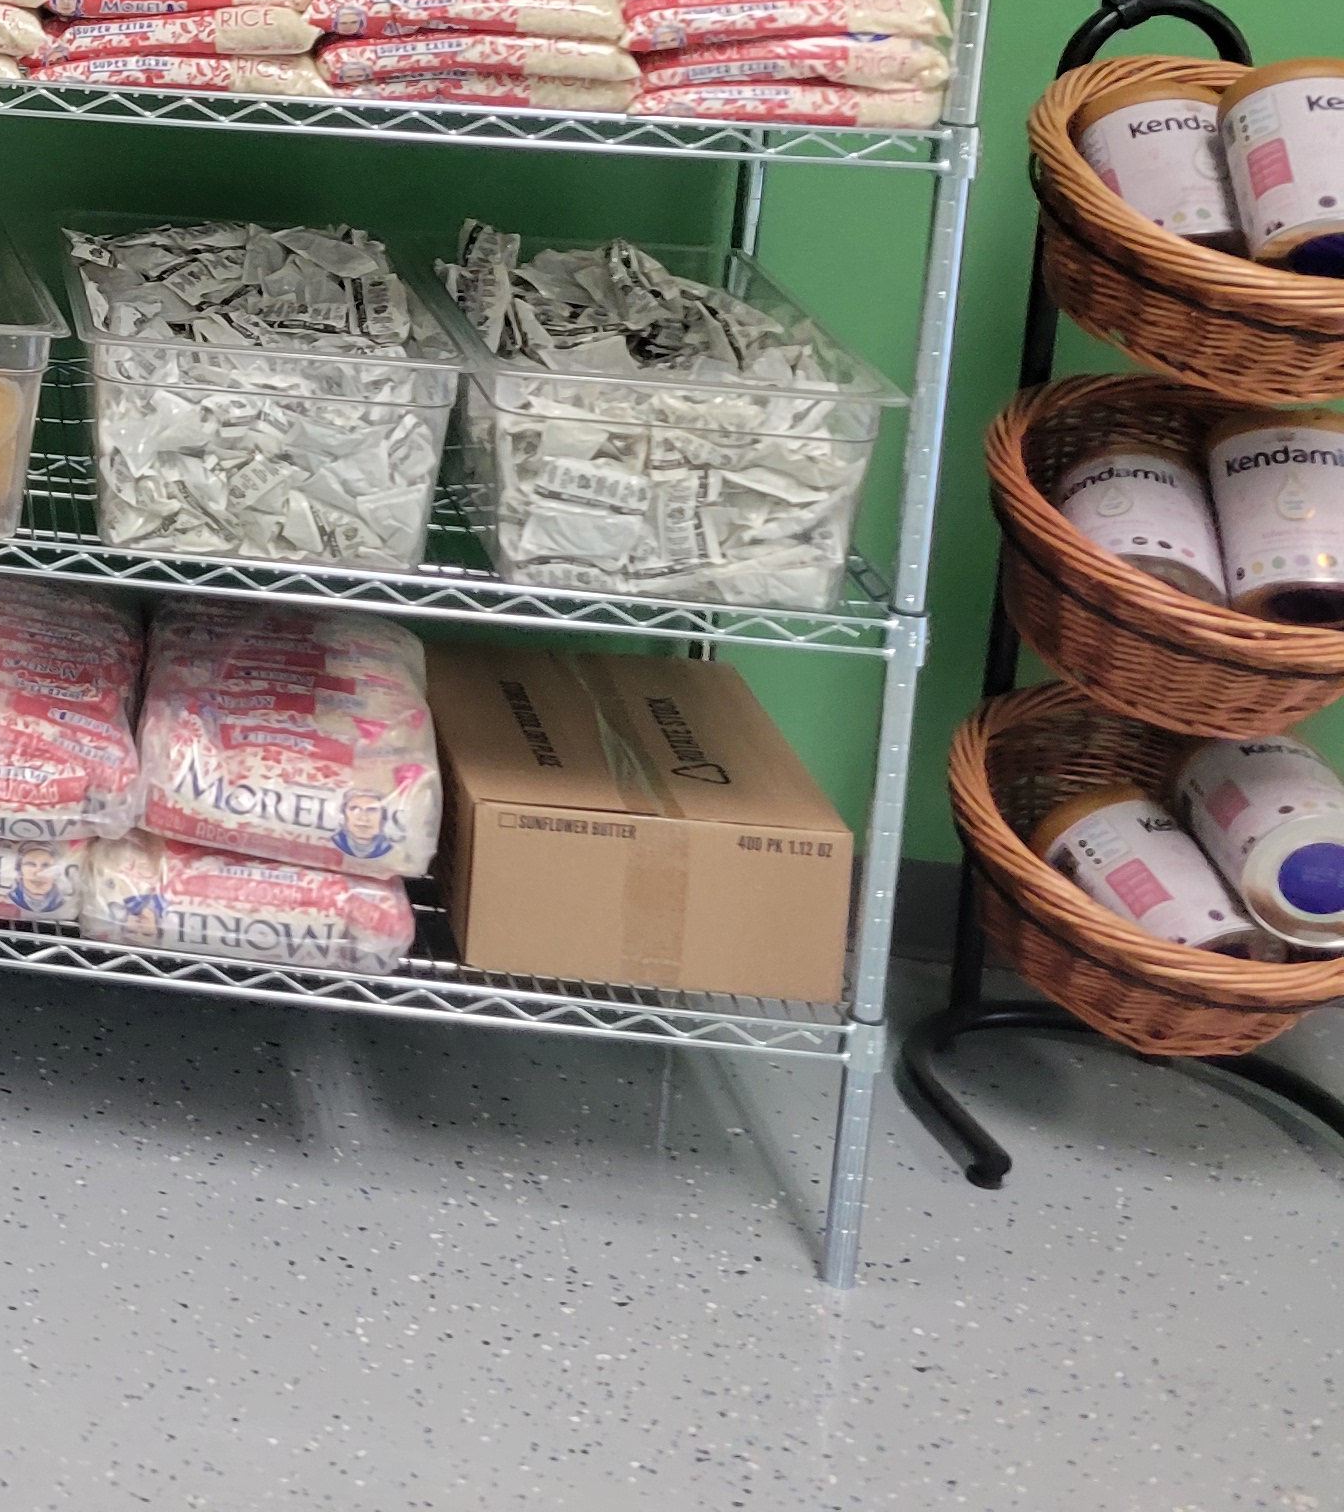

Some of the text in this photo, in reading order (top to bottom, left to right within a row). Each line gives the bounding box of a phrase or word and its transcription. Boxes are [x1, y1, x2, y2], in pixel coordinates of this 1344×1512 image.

[220, 8, 276, 28] RICE
[853, 54, 911, 72] RICE
[174, 758, 406, 844] MORELS
[518, 815, 637, 840] SUNFLOWER BUTTER
[736, 835, 833, 858] 400 PK 1.12 OZ
